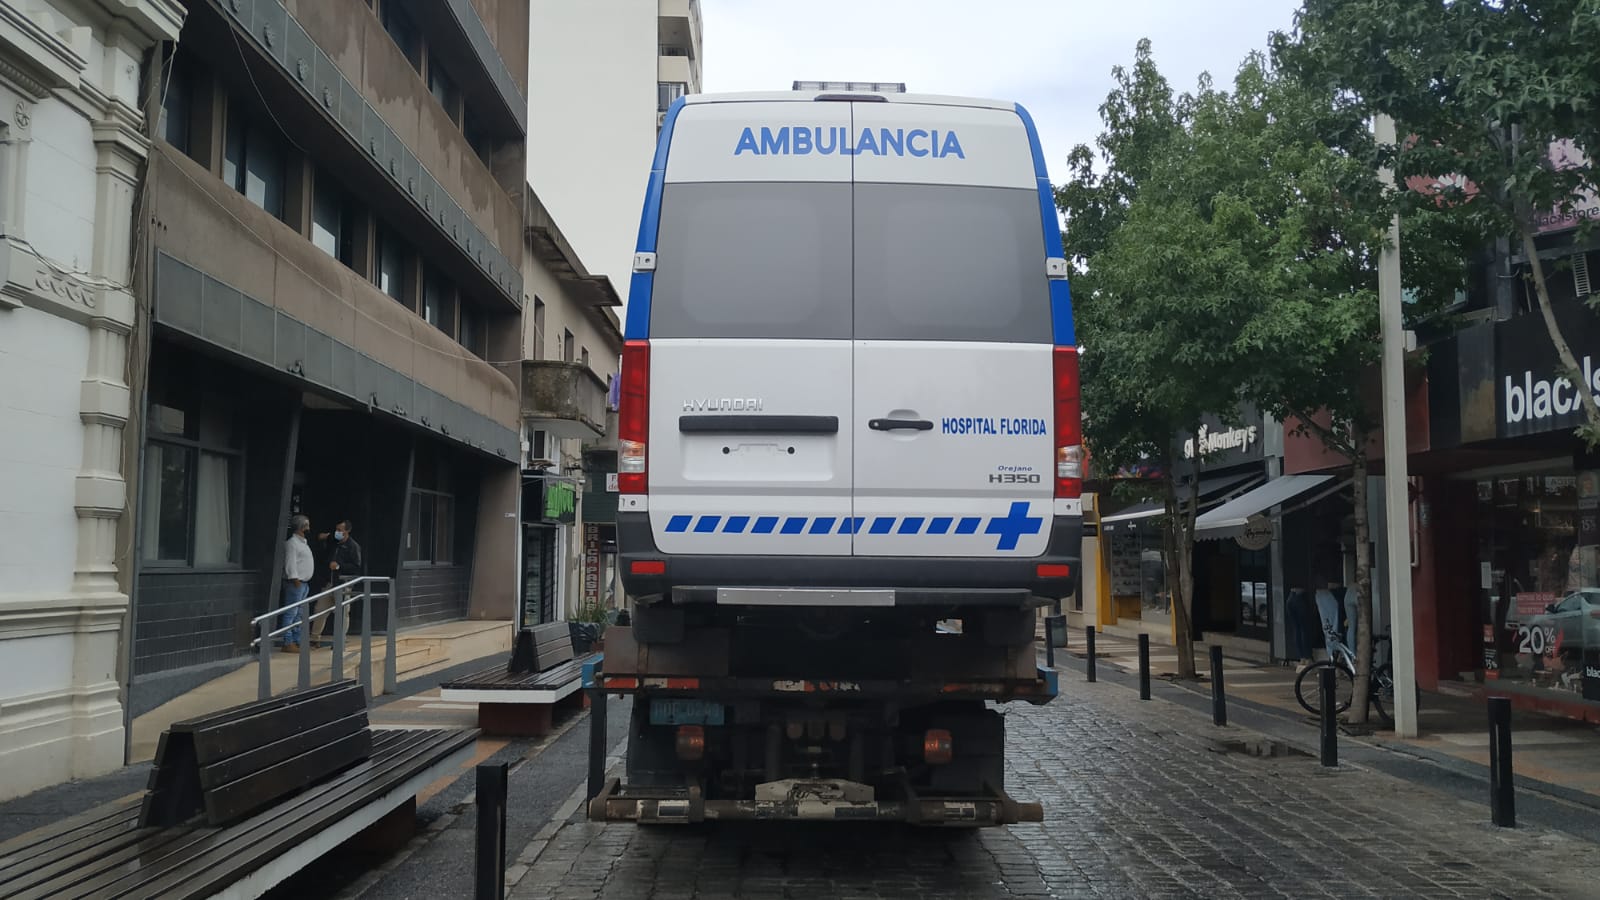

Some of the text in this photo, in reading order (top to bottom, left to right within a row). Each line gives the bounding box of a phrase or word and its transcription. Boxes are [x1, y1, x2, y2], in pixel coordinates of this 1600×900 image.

[734, 126, 966, 160] AMBULANCIA
[683, 398, 763, 412] HYUNDAI
[942, 417, 1047, 435] HOSPITAL FLORIDA
[989, 474, 1041, 484] H350
[587, 523, 598, 563] BRICA
[1518, 626, 1556, 655] 20%
